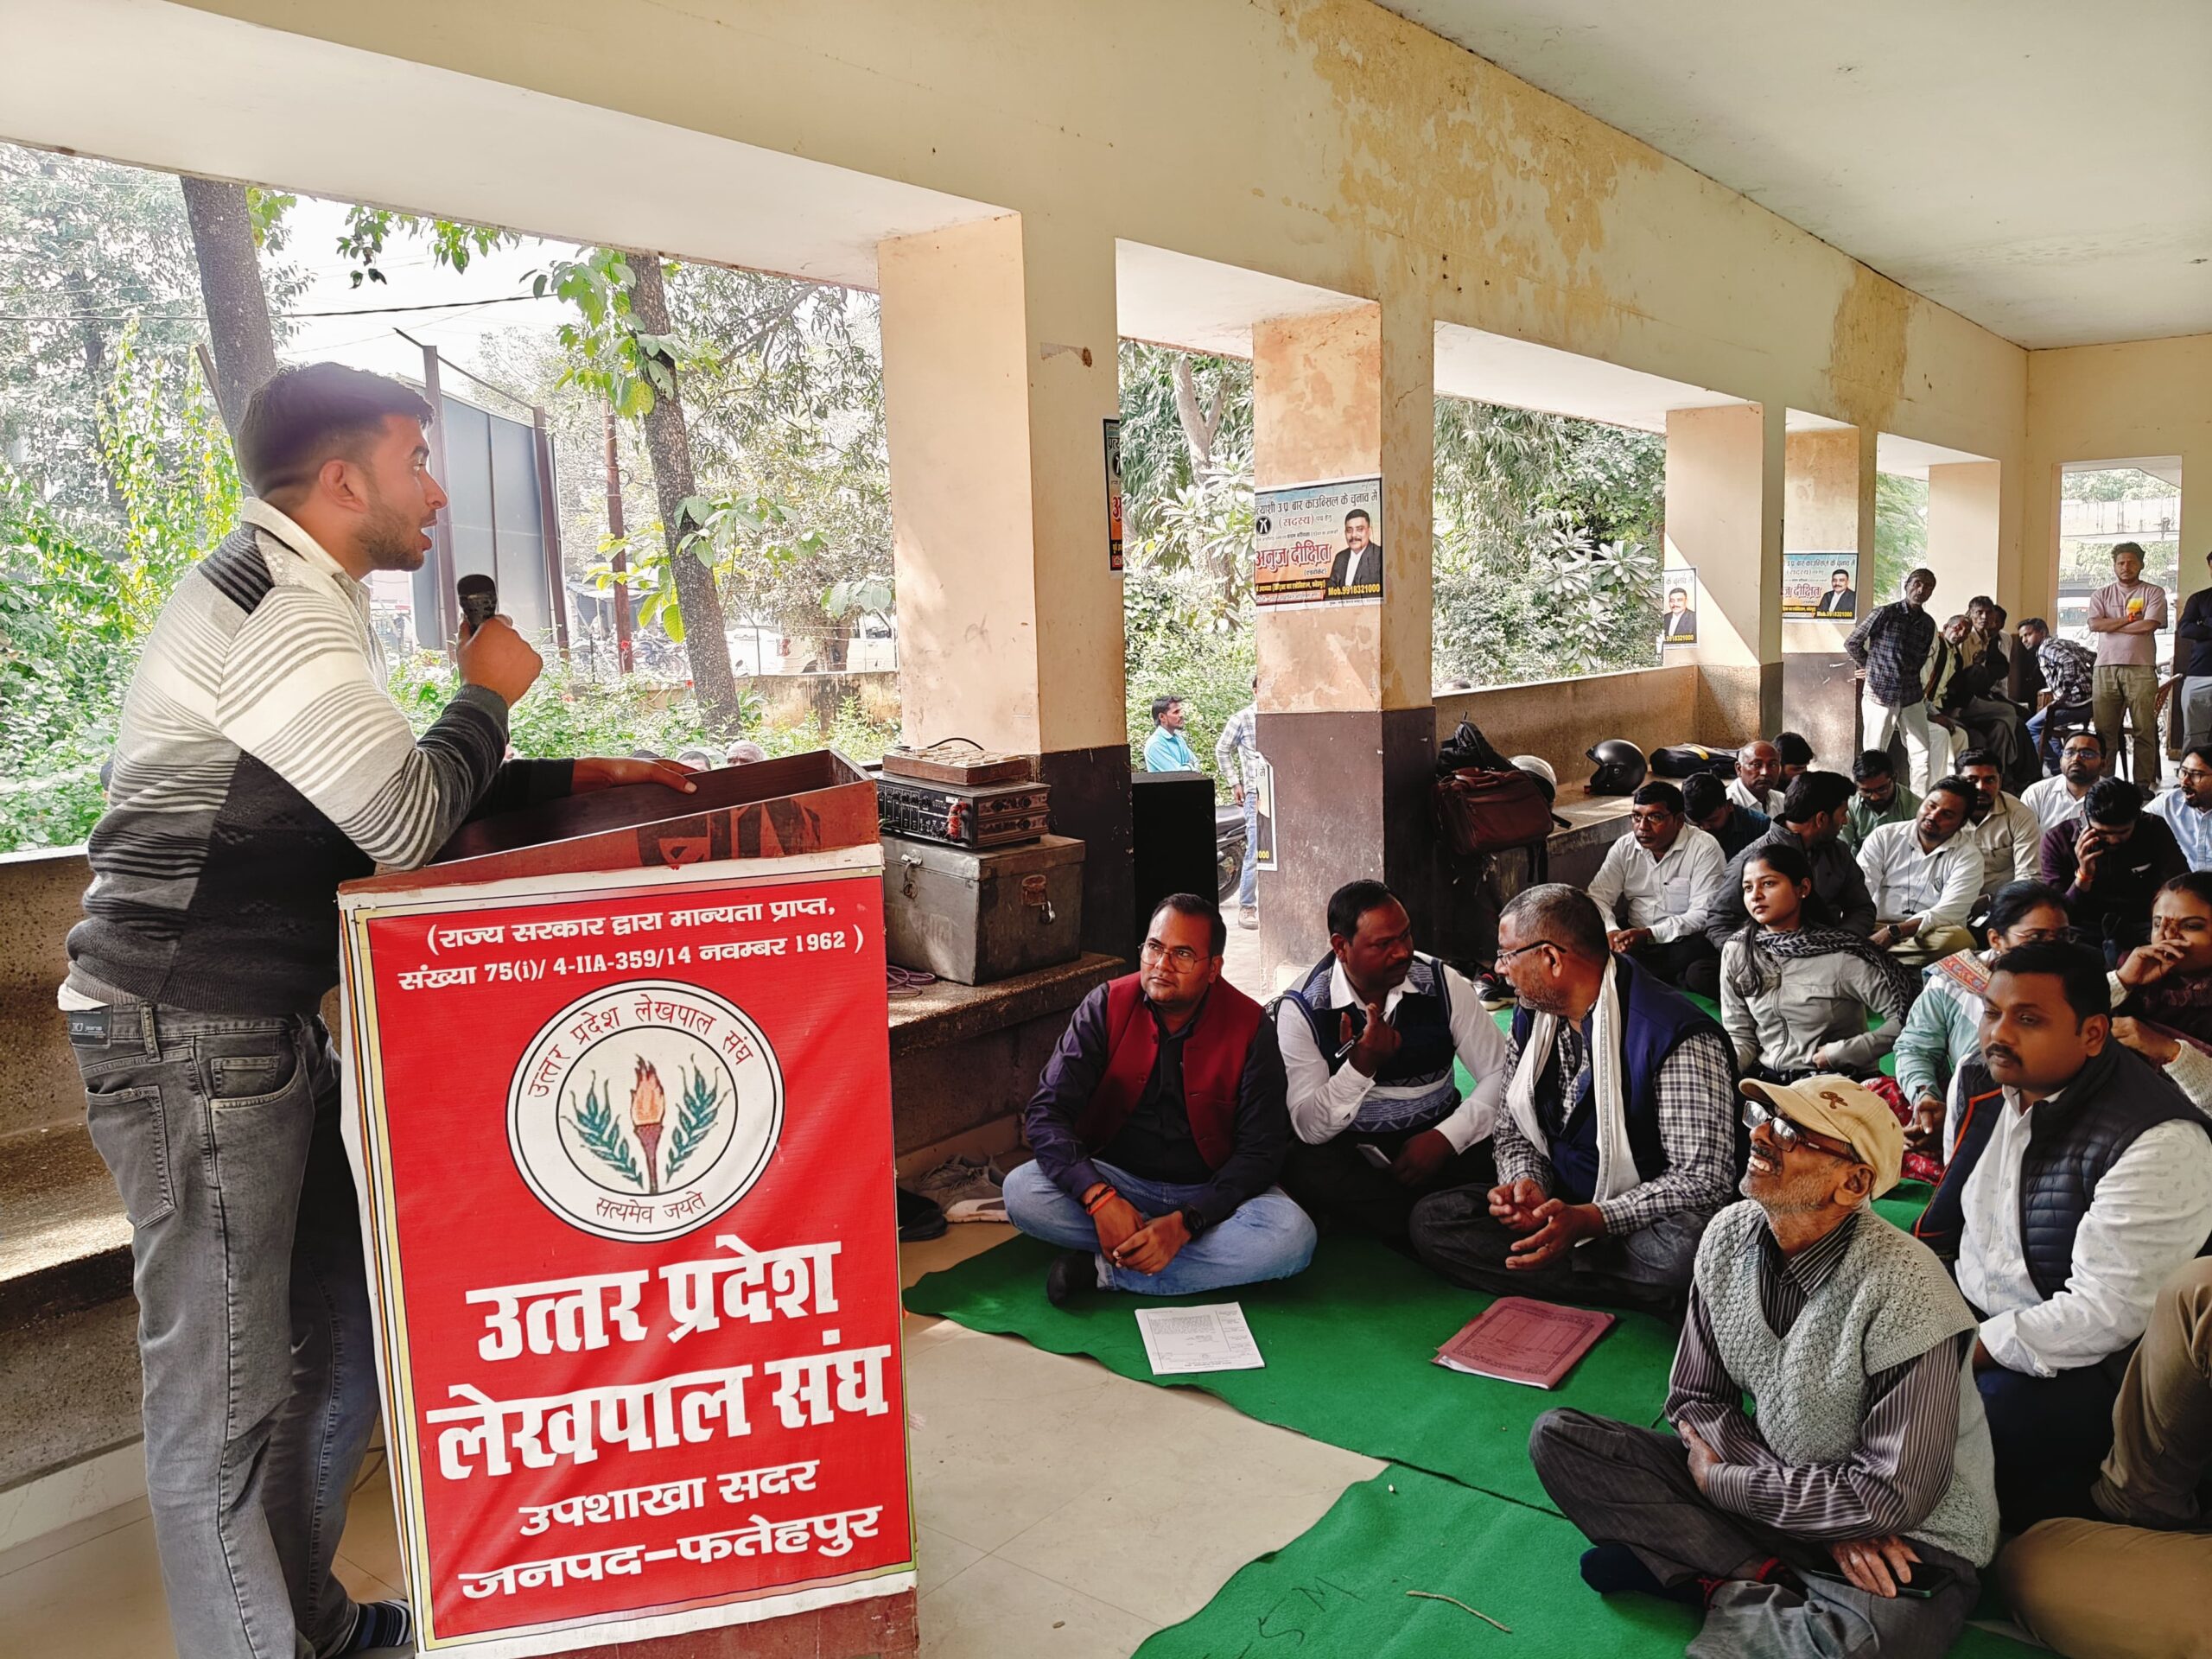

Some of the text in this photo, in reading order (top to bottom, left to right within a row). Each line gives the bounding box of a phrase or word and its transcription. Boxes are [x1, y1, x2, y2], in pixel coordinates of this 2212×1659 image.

[1292, 500, 1303, 511] बार
[1341, 493, 1349, 505] के
[1351, 492, 1370, 507] चुनाव
[1255, 538, 1332, 572] अनुज दीक्षित
[397, 964, 477, 991] संख्या
[484, 958, 546, 983] 75(i)/
[553, 945, 692, 977] 4-IIA-359/14
[699, 938, 788, 963] नवम्बर
[796, 930, 847, 954] 1962
[427, 897, 836, 956] (राज्य सरकार द्वारा मान्यता प्राप्त,
[527, 994, 754, 1098] उत्तर प्रदेश लेखपाल संघ
[595, 1190, 707, 1224] सत्यमेव जयते
[465, 1233, 842, 1363] उत्तर प्रदेश
[426, 1329, 892, 1481] लेखपाल संघ
[518, 1459, 821, 1537] उपशाखा सदर
[458, 1505, 884, 1599] जनपद-फतेहपुर
